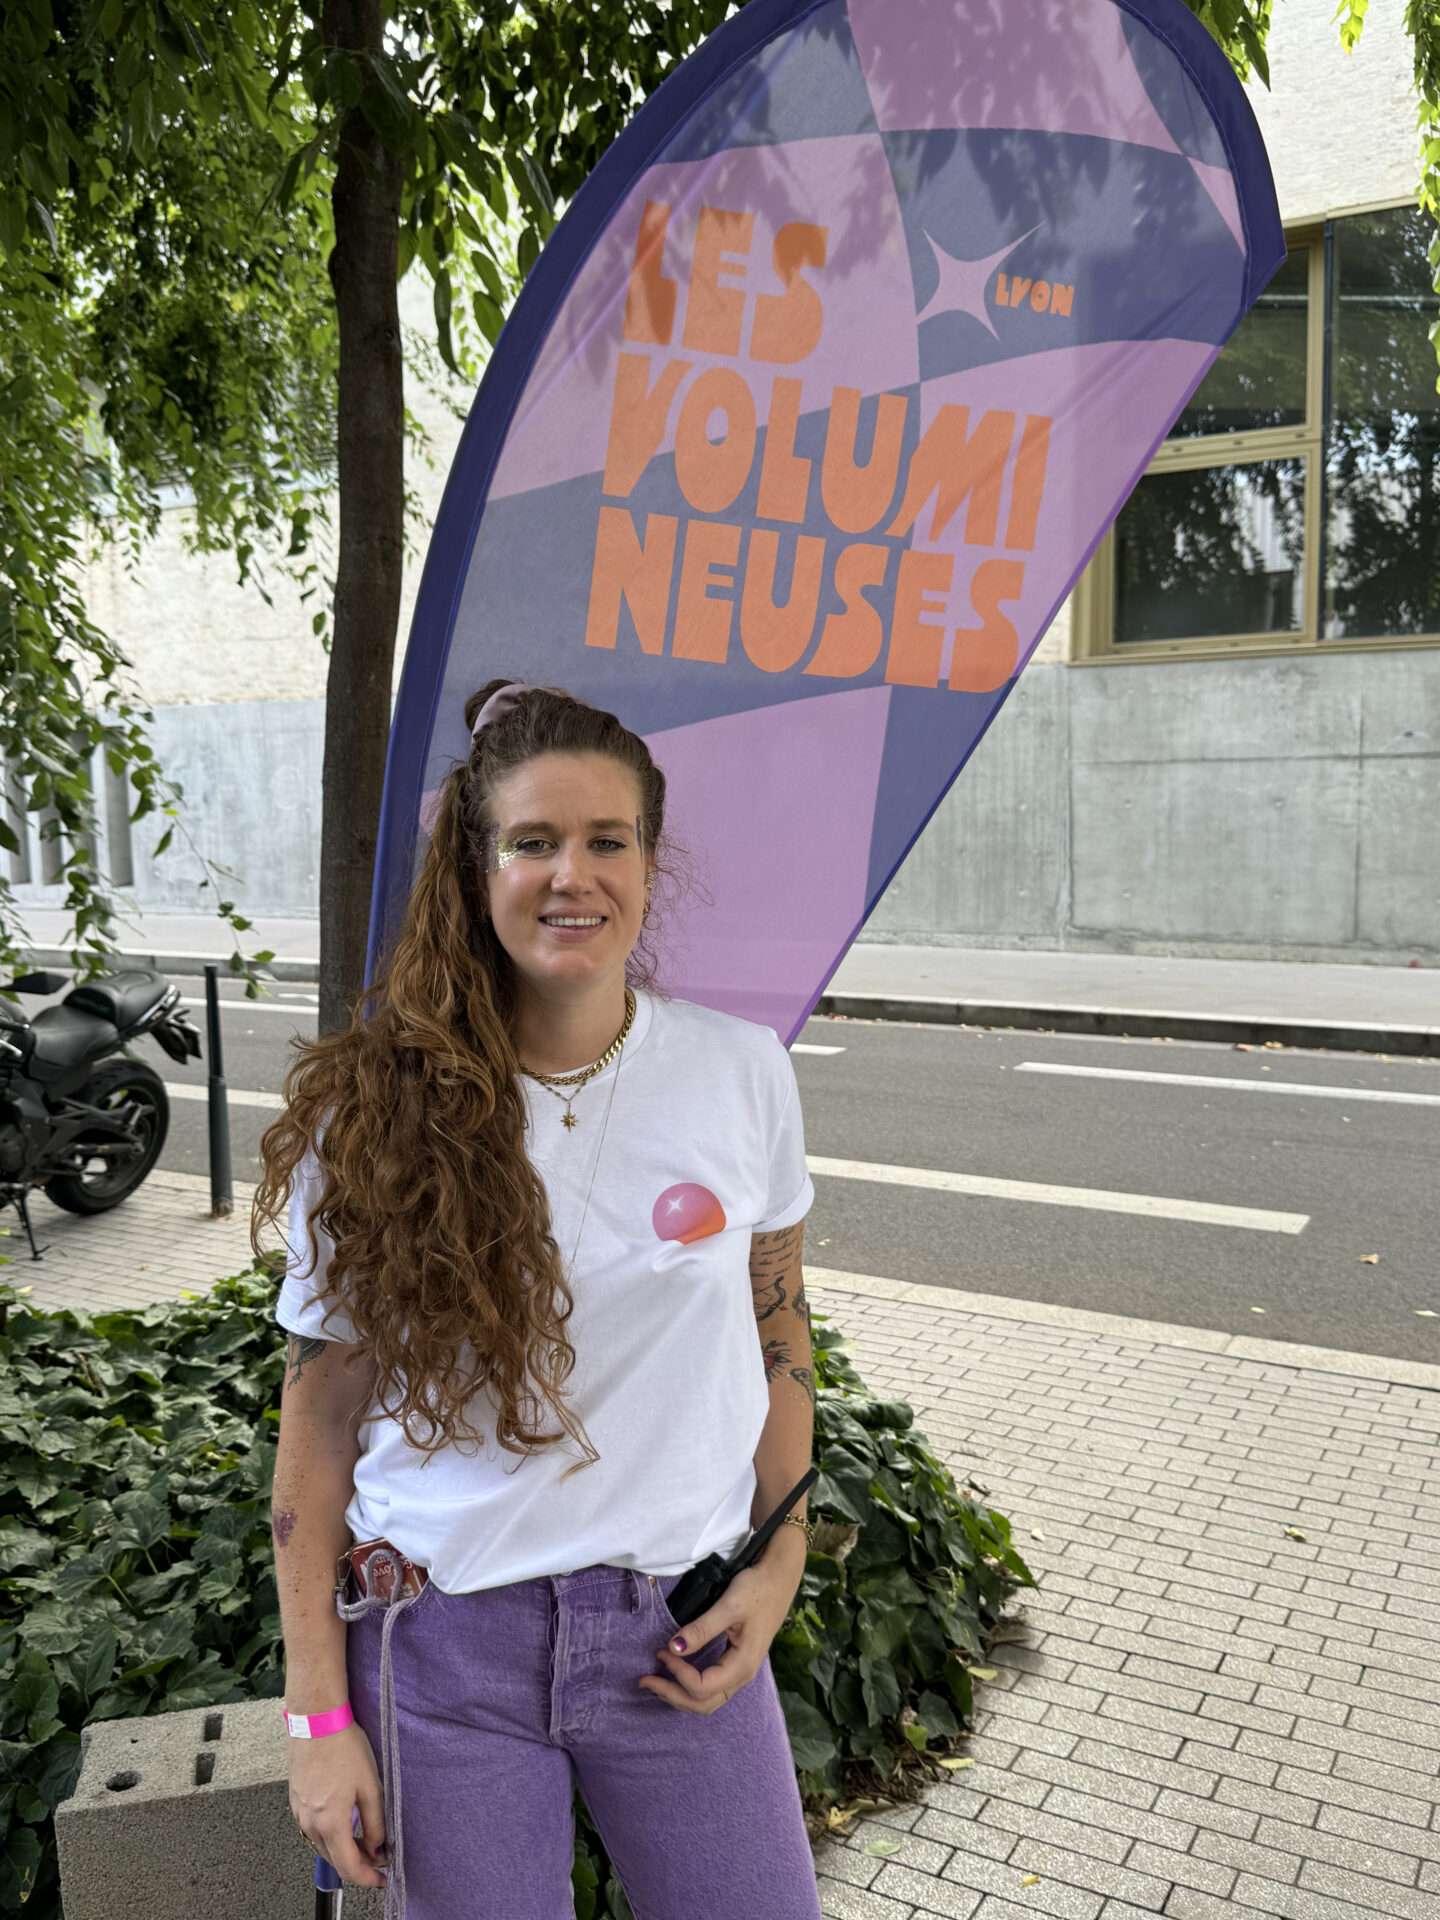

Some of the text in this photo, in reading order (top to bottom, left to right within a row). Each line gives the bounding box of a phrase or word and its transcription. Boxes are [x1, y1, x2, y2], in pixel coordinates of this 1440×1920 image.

[623, 200, 828, 364] LES
[995, 273, 1075, 317] LYON
[602, 352, 1053, 551] VOLUMI
[585, 506, 1025, 693] NEUSES
